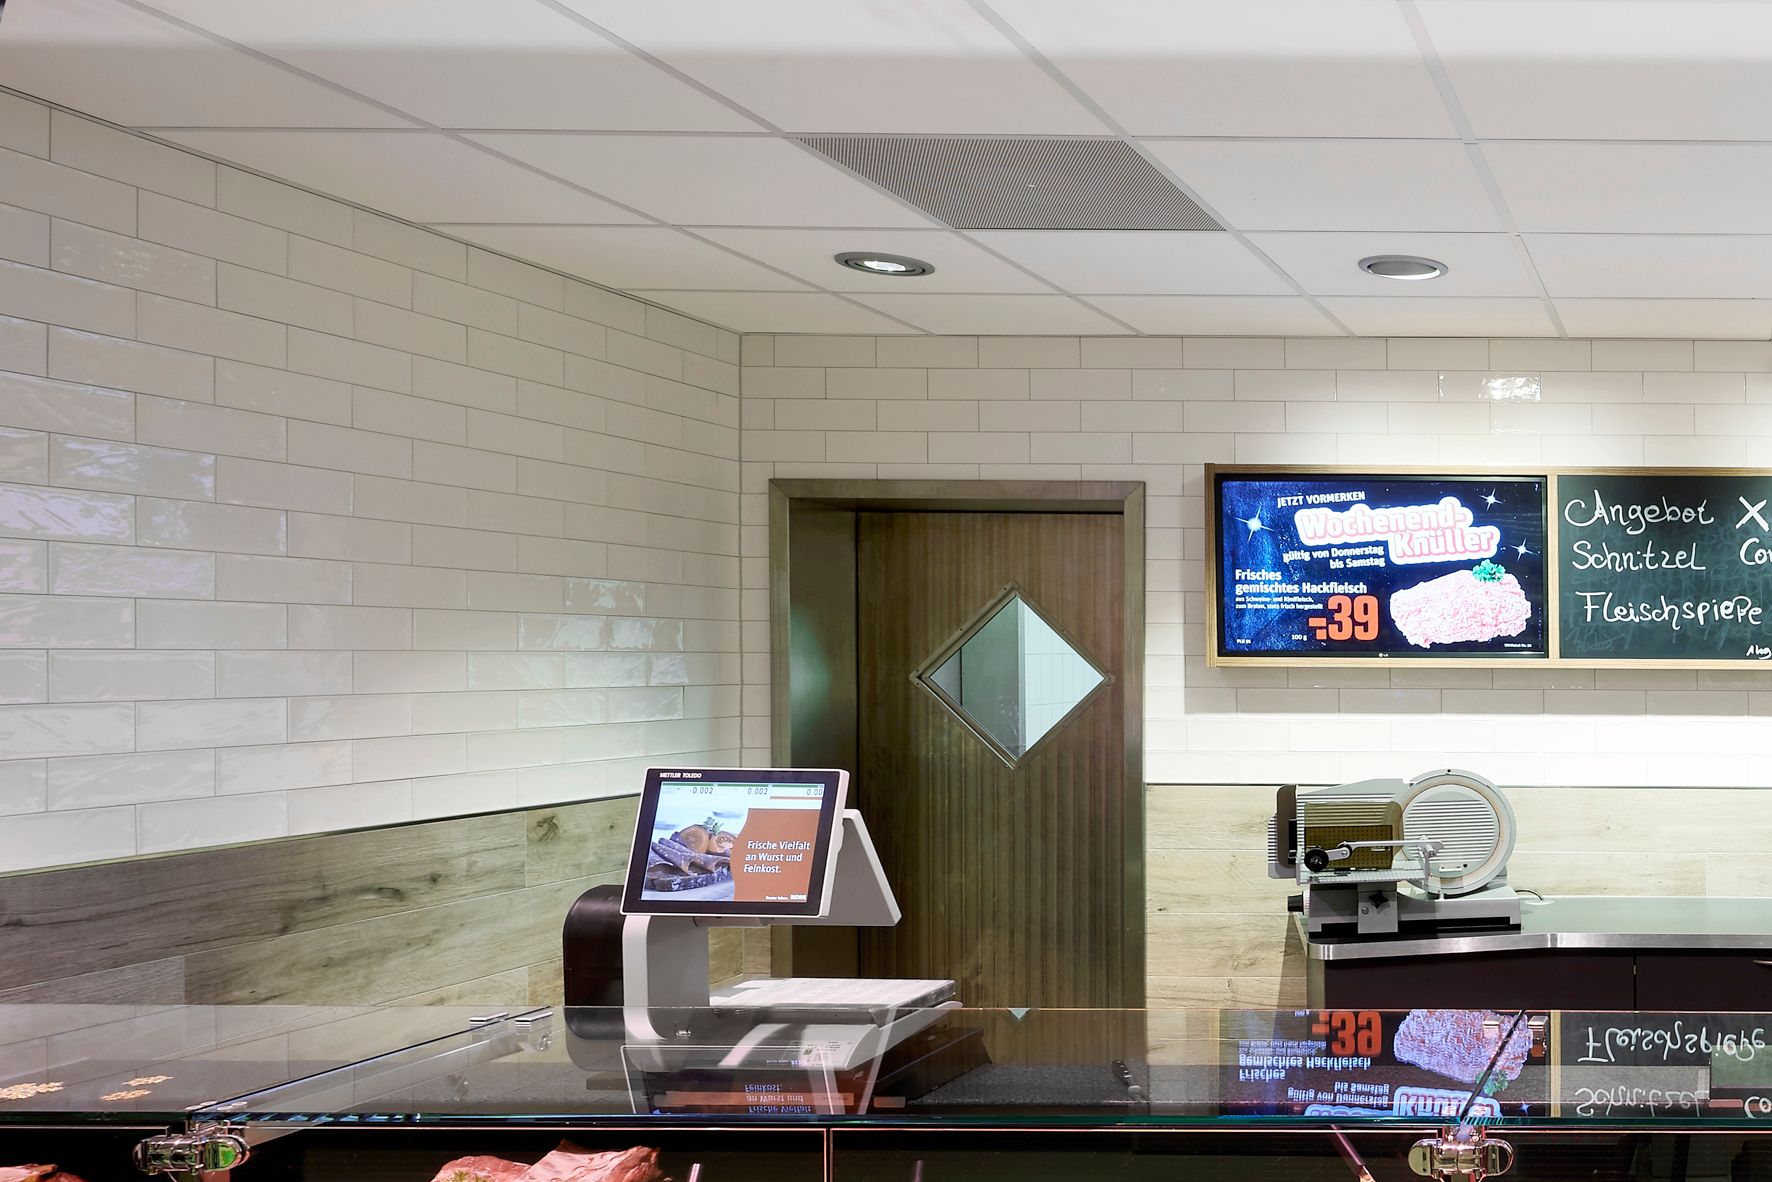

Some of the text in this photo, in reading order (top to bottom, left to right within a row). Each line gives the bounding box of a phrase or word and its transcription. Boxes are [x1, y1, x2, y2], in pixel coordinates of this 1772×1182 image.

[1277, 490, 1366, 508] JETZT VORMERKEN
[1300, 502, 1468, 539] Wochenend-
[1564, 489, 1715, 536] Angebot
[1394, 529, 1494, 559] Knüller
[1283, 545, 1385, 563] gültig von Donnerstag
[1329, 555, 1386, 569] bis Samstag
[1571, 540, 1706, 573] Schnitzel
[1235, 569, 1282, 581] Frisches
[1235, 582, 1368, 595] gemischtes Hackfleisch
[747, 840, 811, 850] Frische Vielfalt
[745, 852, 803, 861] an Wurst und
[743, 863, 782, 873] Feinkost.
